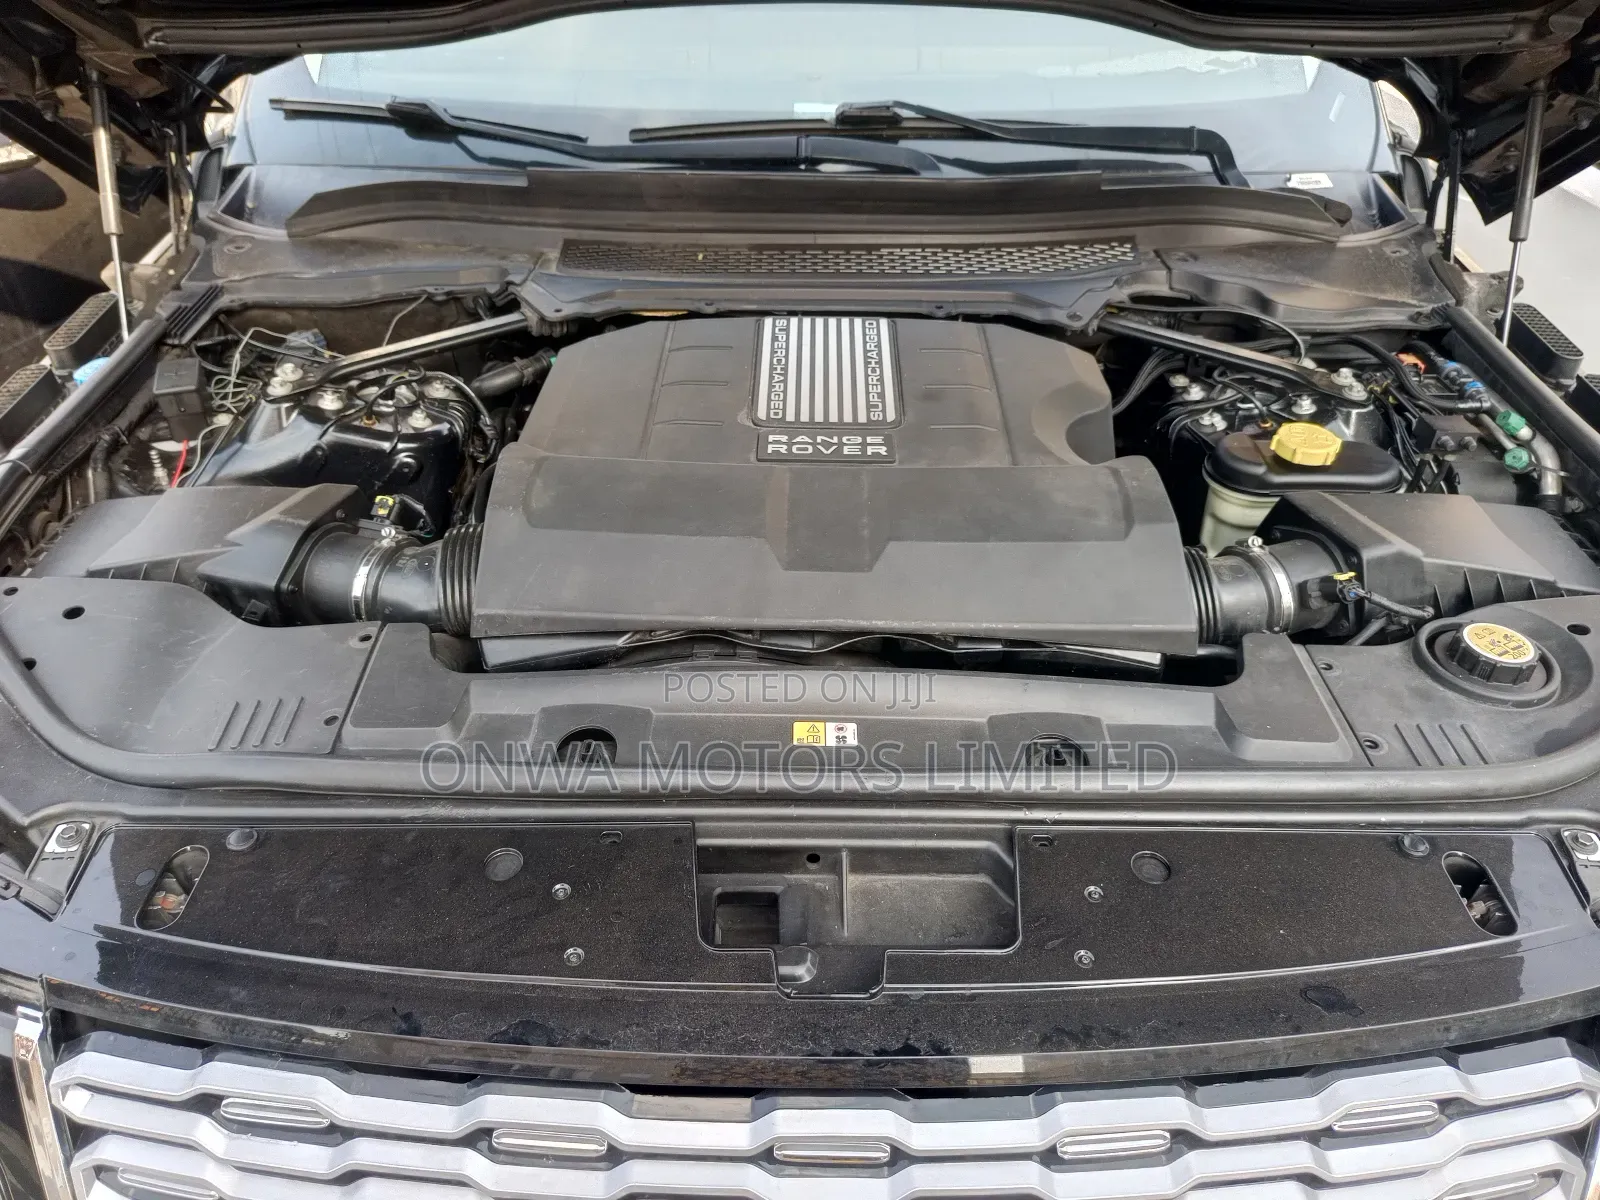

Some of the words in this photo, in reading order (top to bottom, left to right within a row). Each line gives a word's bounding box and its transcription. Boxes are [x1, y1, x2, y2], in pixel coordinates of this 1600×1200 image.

[770, 319, 787, 419] SUPERCHARGED
[866, 320, 883, 420] SUPERCHARGED
[767, 434, 885, 444] RANGE
[767, 445, 888, 455] ROVER
